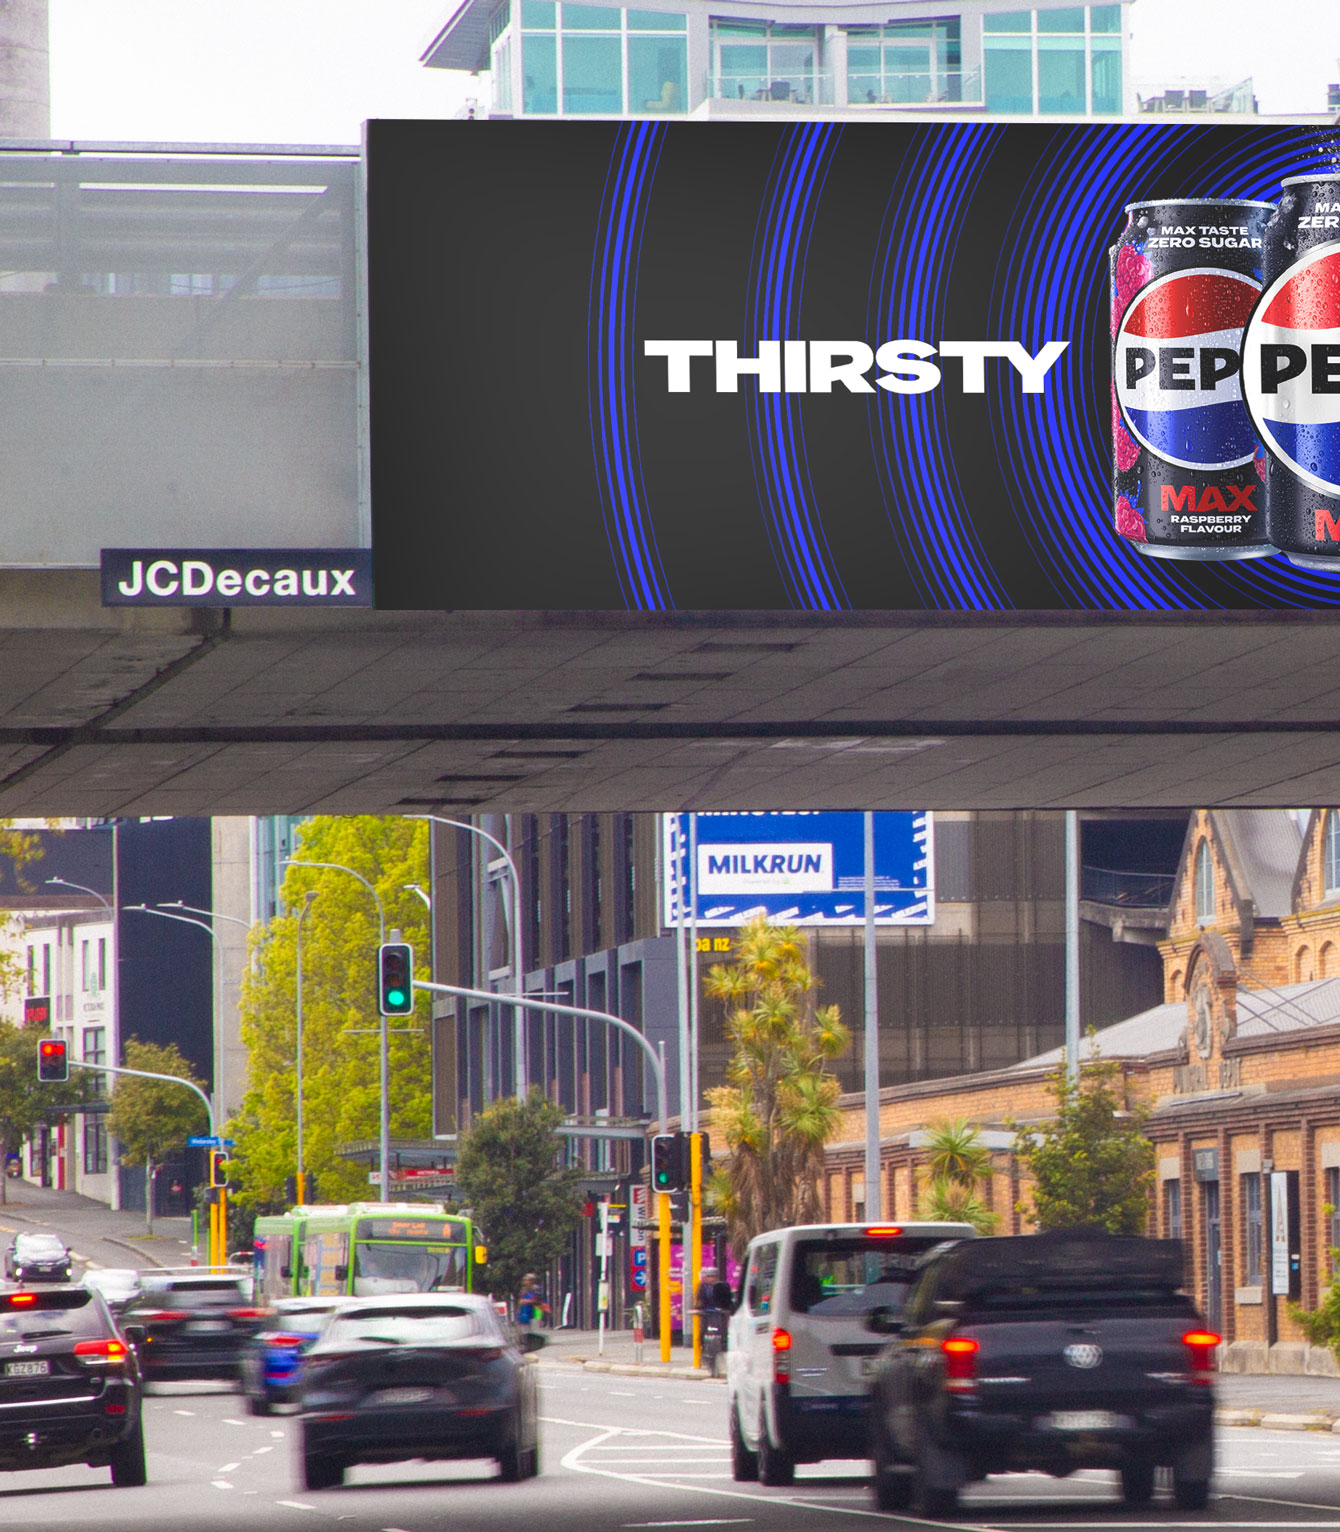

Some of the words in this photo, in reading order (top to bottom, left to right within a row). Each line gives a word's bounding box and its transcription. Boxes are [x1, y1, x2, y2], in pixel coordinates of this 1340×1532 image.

[1161, 226, 1196, 235] MAX
[1198, 226, 1249, 235] TASTE
[1148, 237, 1196, 248] ZERO
[1198, 237, 1262, 249] SUGAR
[644, 339, 1070, 395] THIRSTY
[1125, 347, 1240, 391] PEP
[1160, 484, 1258, 512] MAX
[1171, 515, 1252, 524] RASPBERRY
[1180, 524, 1242, 533] FLAVOUR
[117, 560, 357, 597] JCDecaux
[708, 854, 822, 874] MILKRUN
[713, 937, 730, 951] nz
